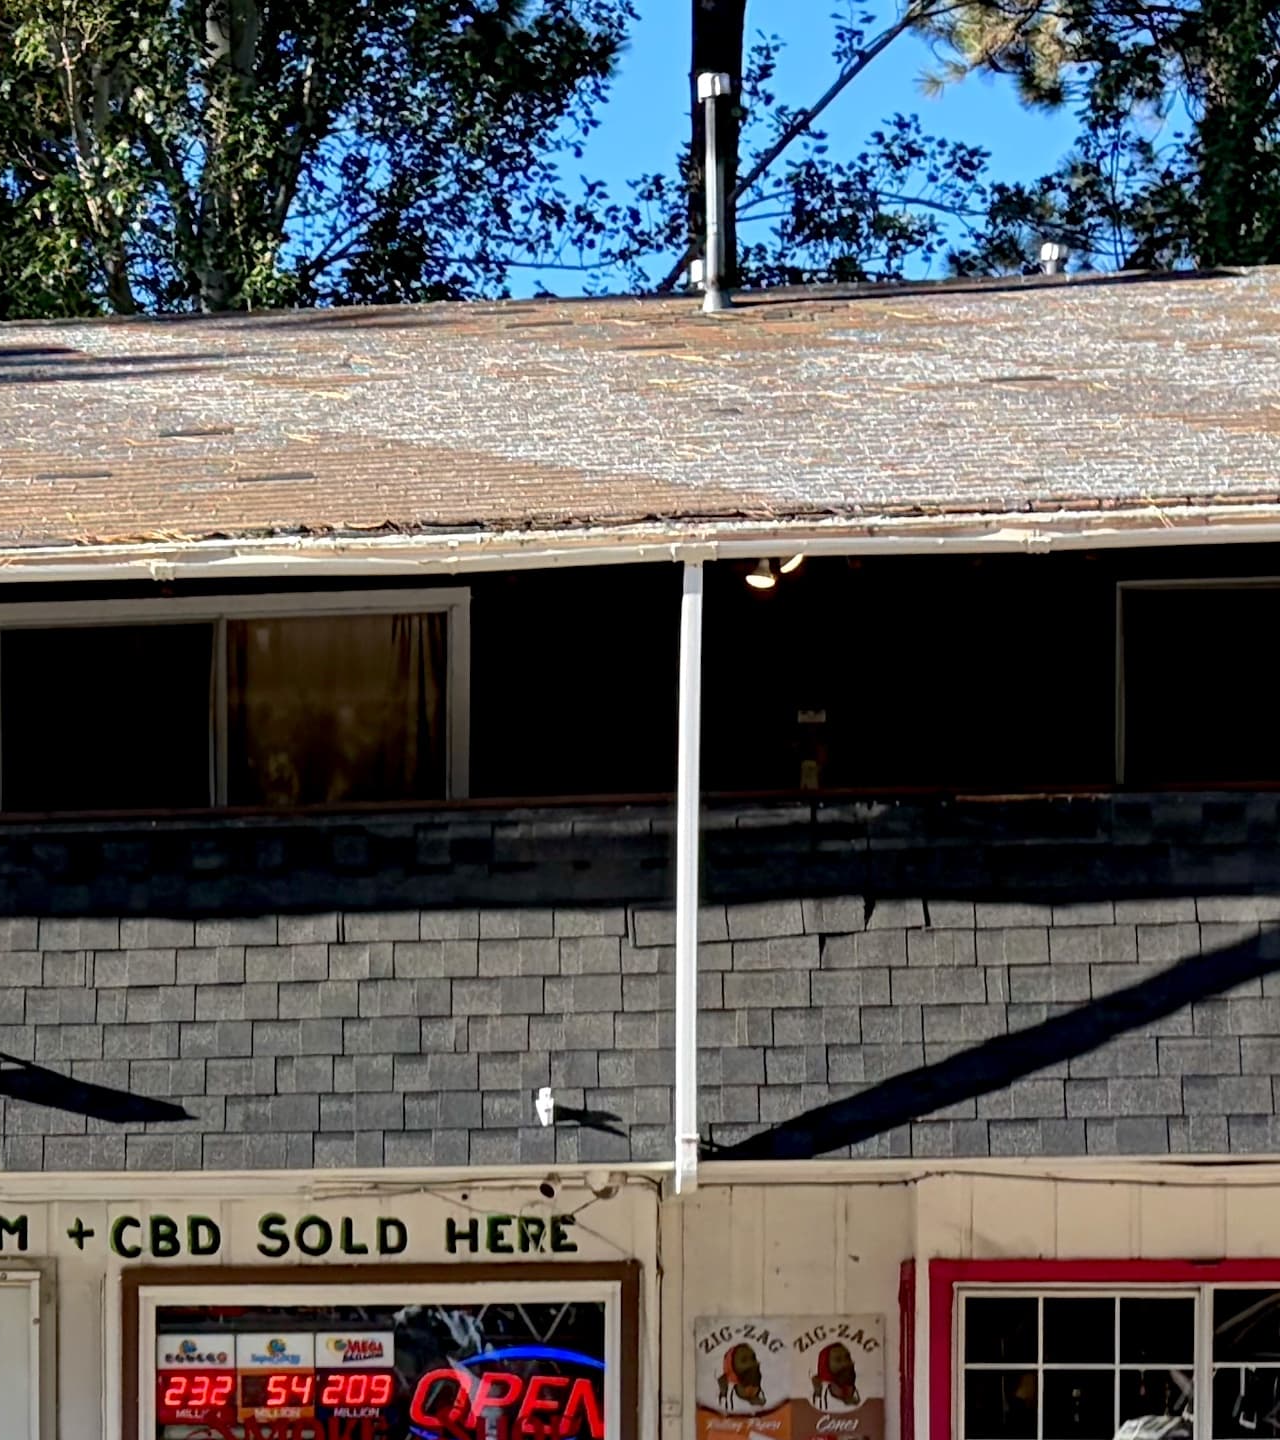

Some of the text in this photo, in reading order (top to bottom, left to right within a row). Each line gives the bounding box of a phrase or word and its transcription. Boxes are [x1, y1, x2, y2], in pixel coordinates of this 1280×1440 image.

[257, 1214, 409, 1257] SOLD
[445, 1215, 580, 1255] HERE
[699, 1323, 785, 1355] ZIG-ZAG
[793, 1323, 881, 1354] ZIG-ZAG
[164, 1374, 392, 1406] 232 54 209
[410, 1368, 606, 1439] OPEN
[254, 1408, 301, 1418] MILLION
[333, 1407, 380, 1418] MILLION
